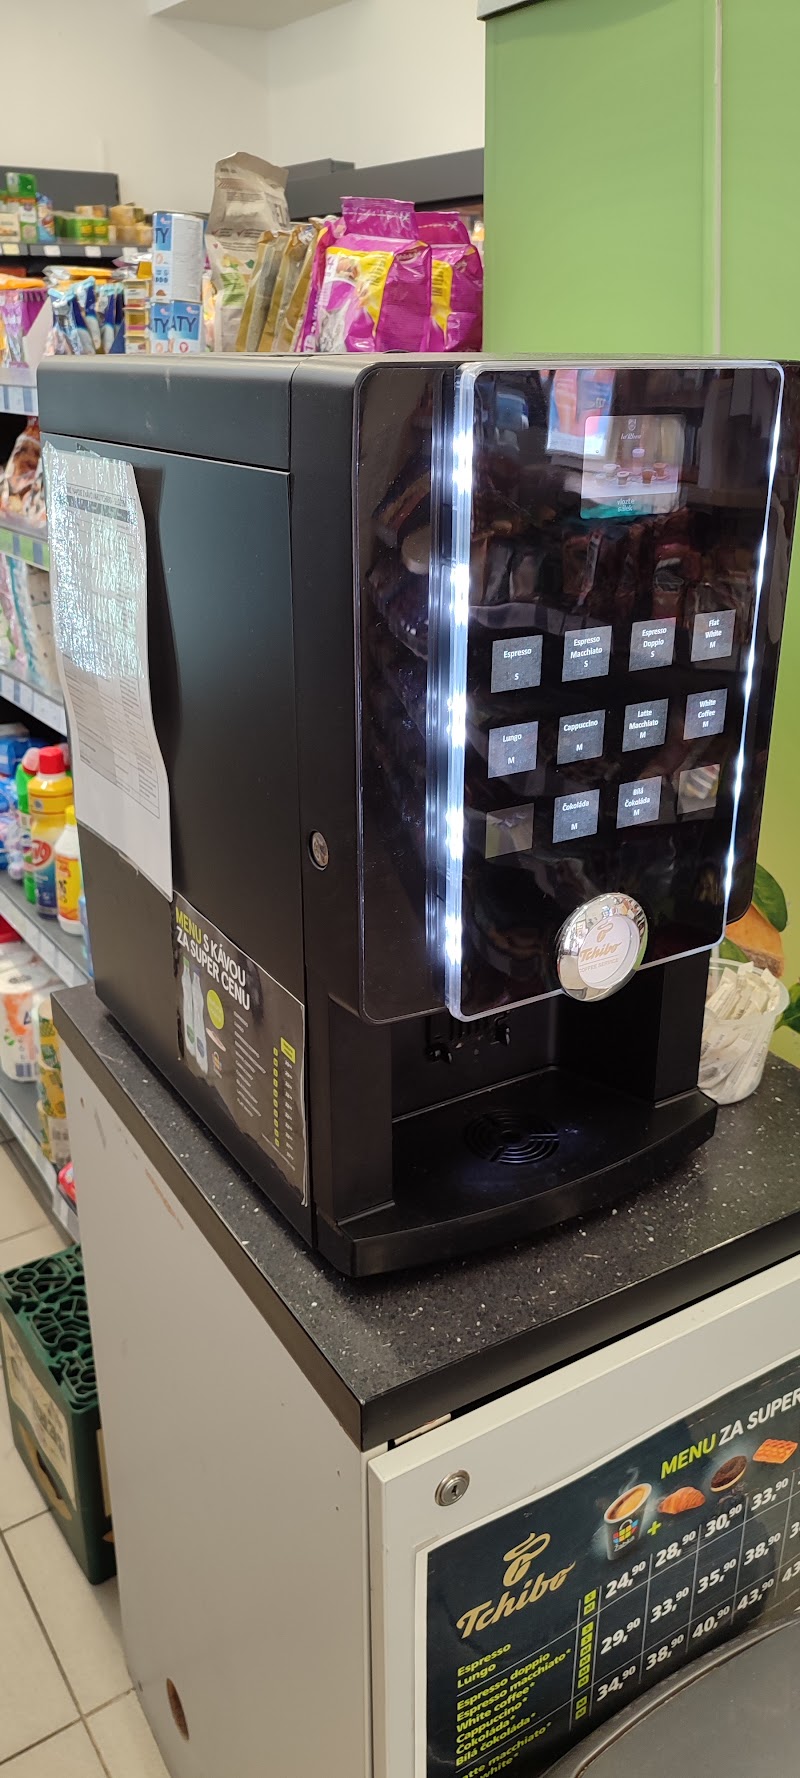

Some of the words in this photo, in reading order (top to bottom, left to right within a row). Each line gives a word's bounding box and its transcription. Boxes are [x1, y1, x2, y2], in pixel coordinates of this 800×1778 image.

[708, 619, 720, 627] Flat
[642, 627, 667, 638] Espresso
[705, 629, 722, 638] White
[573, 635, 601, 647] Espresso
[643, 638, 664, 648] Doppio
[503, 647, 532, 659] Espresso
[570, 646, 602, 659] Macchiato
[699, 699, 716, 708] White
[637, 709, 652, 717] Latte
[698, 709, 716, 719] Coffee
[563, 719, 598, 732] Cappuccino
[629, 719, 659, 730] Macchiato
[503, 733, 522, 743] Lungo
[508, 756, 515, 764] M
[562, 800, 589, 811] Čokoláda
[176, 907, 201, 944] MENU
[204, 934, 209, 952] S
[211, 940, 245, 986] KÁVOU
[581, 942, 622, 962] Tchibo
[176, 926, 189, 952] ZA
[190, 939, 219, 983] SUPER
[221, 971, 250, 1010] CENU
[661, 1433, 716, 1479] MENU
[718, 1420, 744, 1446] ZA
[747, 1387, 800, 1430] SUPER
[605, 1560, 646, 1599] 24,90
[655, 1530, 696, 1568] 28,90
[705, 1504, 742, 1538] 30,90
[751, 1478, 789, 1511] 33,90
[456, 1560, 576, 1639] Tchibo
[601, 1617, 640, 1654] 29,90
[650, 1586, 689, 1623] 33,90
[697, 1559, 736, 1594] 35,90
[744, 1533, 781, 1566] 38,90
[597, 1665, 636, 1702] 34,90
[646, 1634, 684, 1670] 38,90
[737, 1578, 774, 1611] 43,90
[458, 1644, 511, 1677] Espresso
[457, 1678, 508, 1710] Espresso
[510, 1653, 550, 1680] doppio
[458, 1663, 496, 1688] Lungo
[457, 1690, 507, 1722] Espresso
[457, 1710, 491, 1733] White
[456, 1748, 478, 1766] Bílá
[463, 1764, 485, 1778] atte
